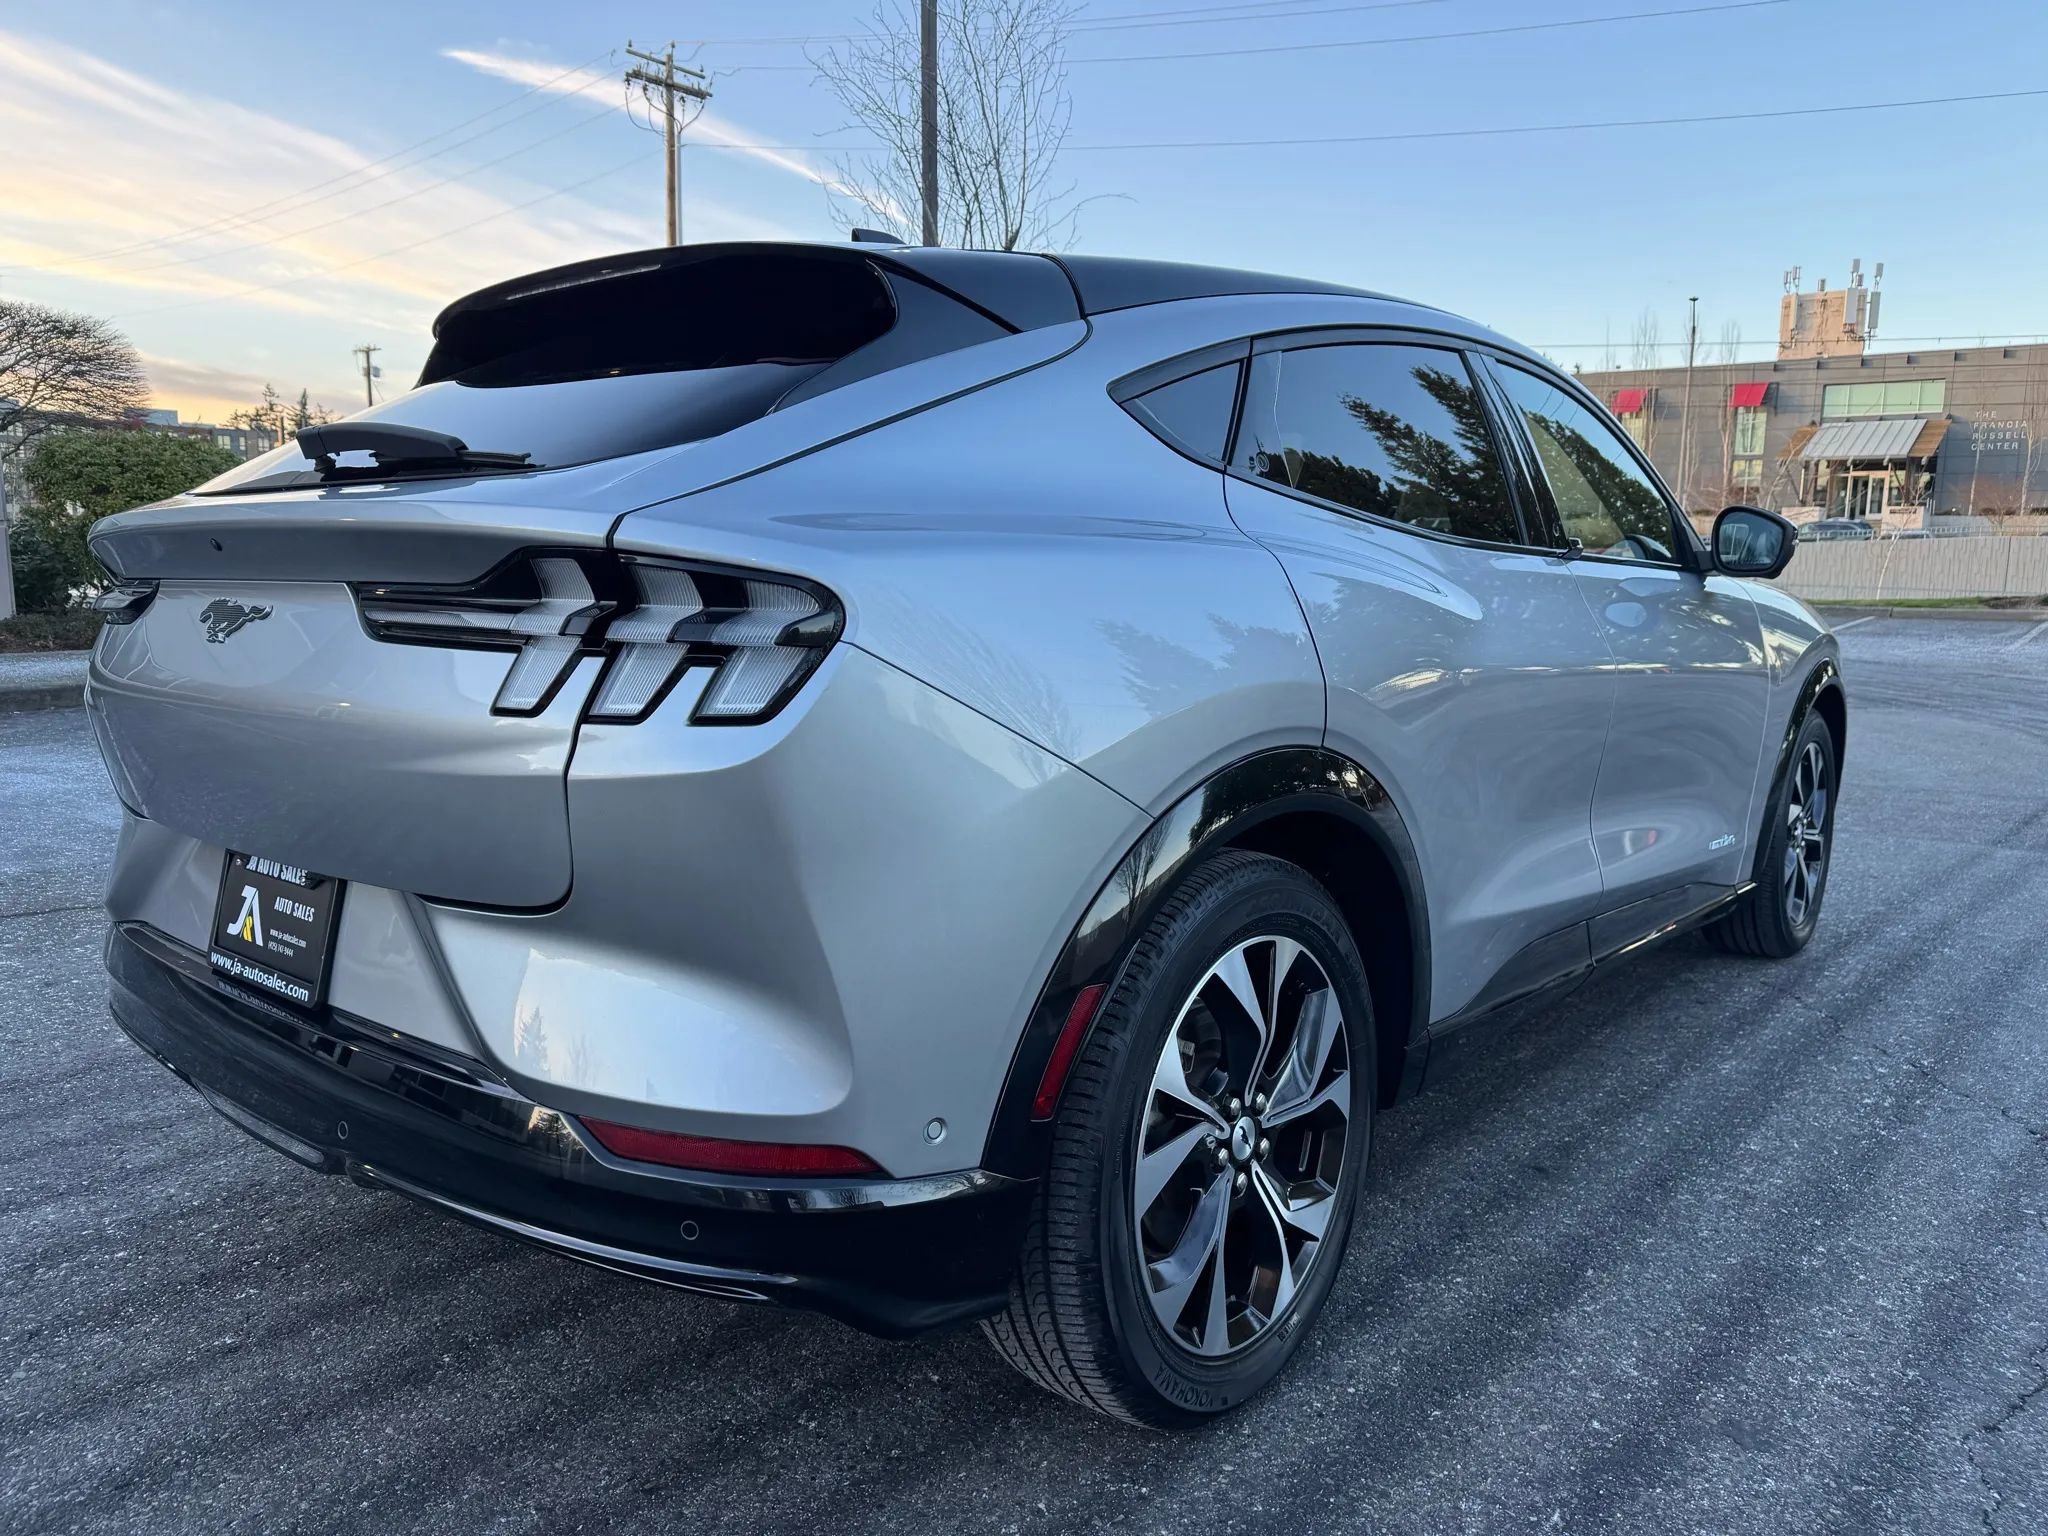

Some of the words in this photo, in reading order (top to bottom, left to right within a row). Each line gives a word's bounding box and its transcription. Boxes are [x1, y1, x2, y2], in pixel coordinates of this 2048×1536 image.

[1976, 410, 1997, 418] THE
[1971, 441, 2018, 450] CENTER
[1972, 431, 2026, 440] RUSSELL
[257, 858, 281, 878] AUTO
[274, 896, 293, 915] AUTO
[293, 902, 316, 923] SALES
[211, 951, 309, 1002] www.ja-autosales.com
[1154, 1364, 1214, 1408] YOKOHAMA
